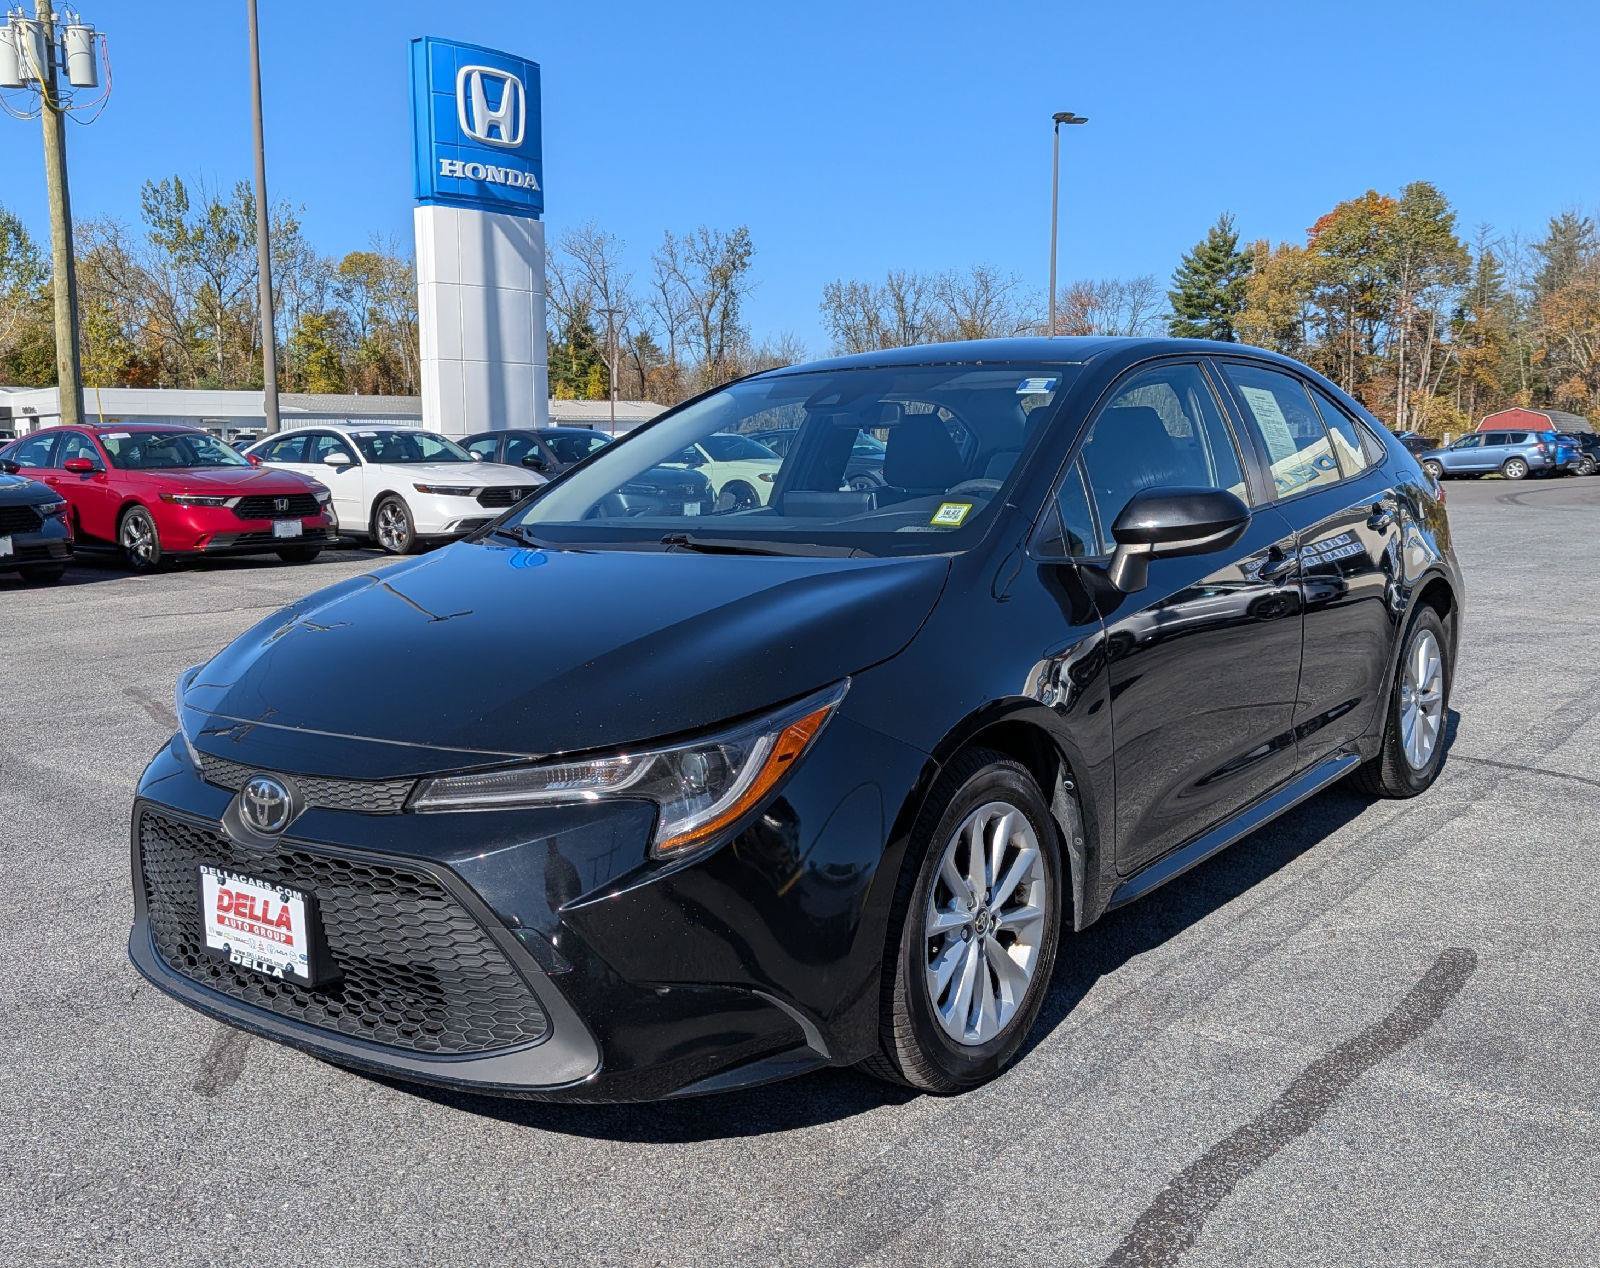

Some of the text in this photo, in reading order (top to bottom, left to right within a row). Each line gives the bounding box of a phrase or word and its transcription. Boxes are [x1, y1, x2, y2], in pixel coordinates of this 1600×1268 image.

[439, 158, 541, 191] HONDA
[200, 865, 302, 901] DELLACARS.COM
[217, 886, 292, 932] DELLA
[224, 916, 250, 932] AUTO
[254, 925, 287, 942] GROUP
[229, 953, 285, 979] DELLA
